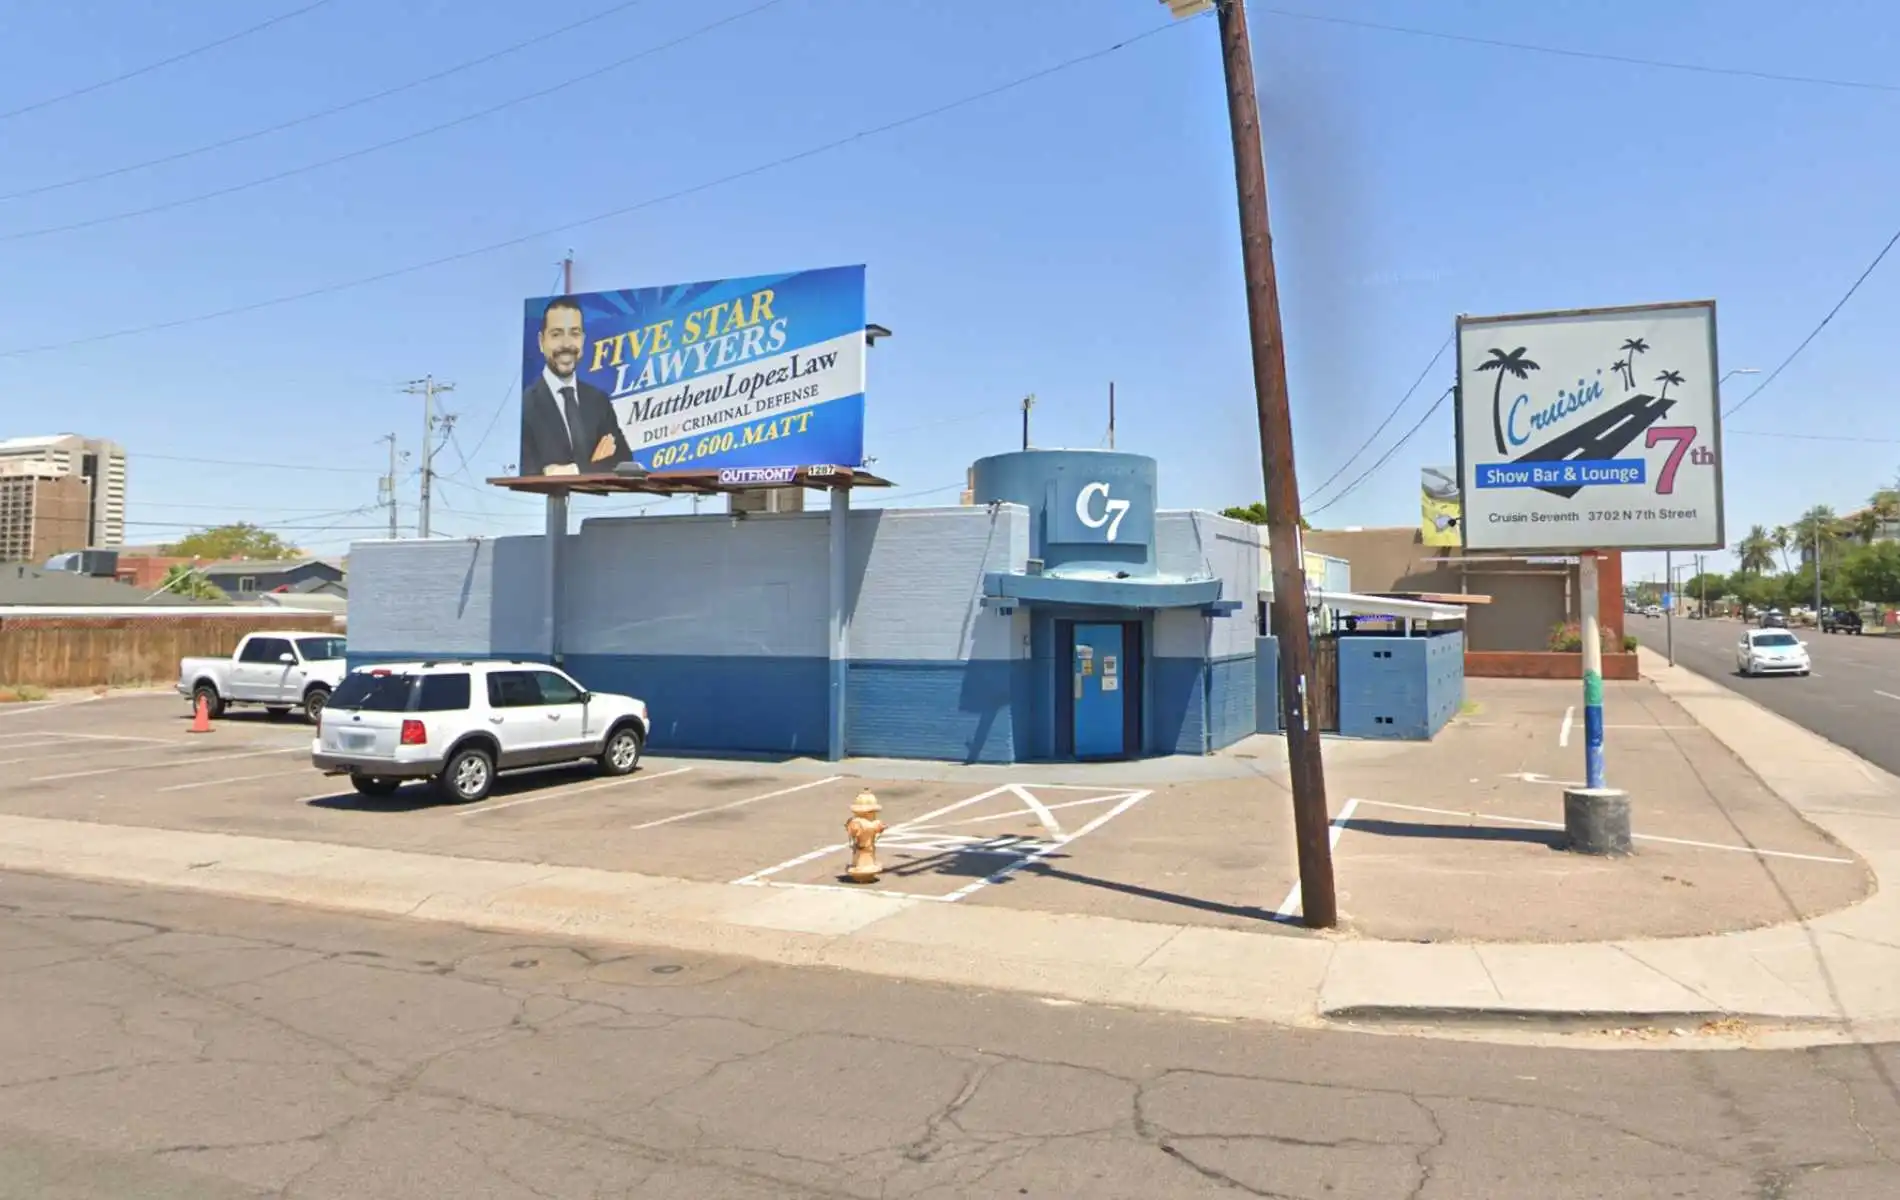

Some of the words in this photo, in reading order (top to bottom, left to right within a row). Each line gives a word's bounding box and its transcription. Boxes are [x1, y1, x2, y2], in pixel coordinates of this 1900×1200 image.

[589, 320, 673, 372] FIVE
[681, 288, 775, 345] STAR
[611, 316, 788, 397] LAWYERS
[626, 351, 839, 426] MatthewLopezLaw
[643, 425, 668, 443] DUI
[682, 406, 752, 432] CRIMINAL
[755, 384, 819, 414] DEFENSE
[651, 411, 813, 469] 602.600.MATT
[1645, 426, 1715, 495] 7th
[721, 468, 793, 482] OUTFRONT
[1486, 469, 1529, 484] Show
[1533, 467, 1559, 482] Bar
[1564, 467, 1577, 481] &
[1581, 466, 1640, 484] Lounge
[1075, 481, 1131, 542] C7
[1488, 512, 1528, 523] Cruisin
[1531, 511, 1580, 522] Seventh
[1588, 511, 1621, 521] 3702
[1623, 510, 1632, 520] N
[1636, 509, 1656, 520] 7th
[1659, 508, 1698, 519] Street
